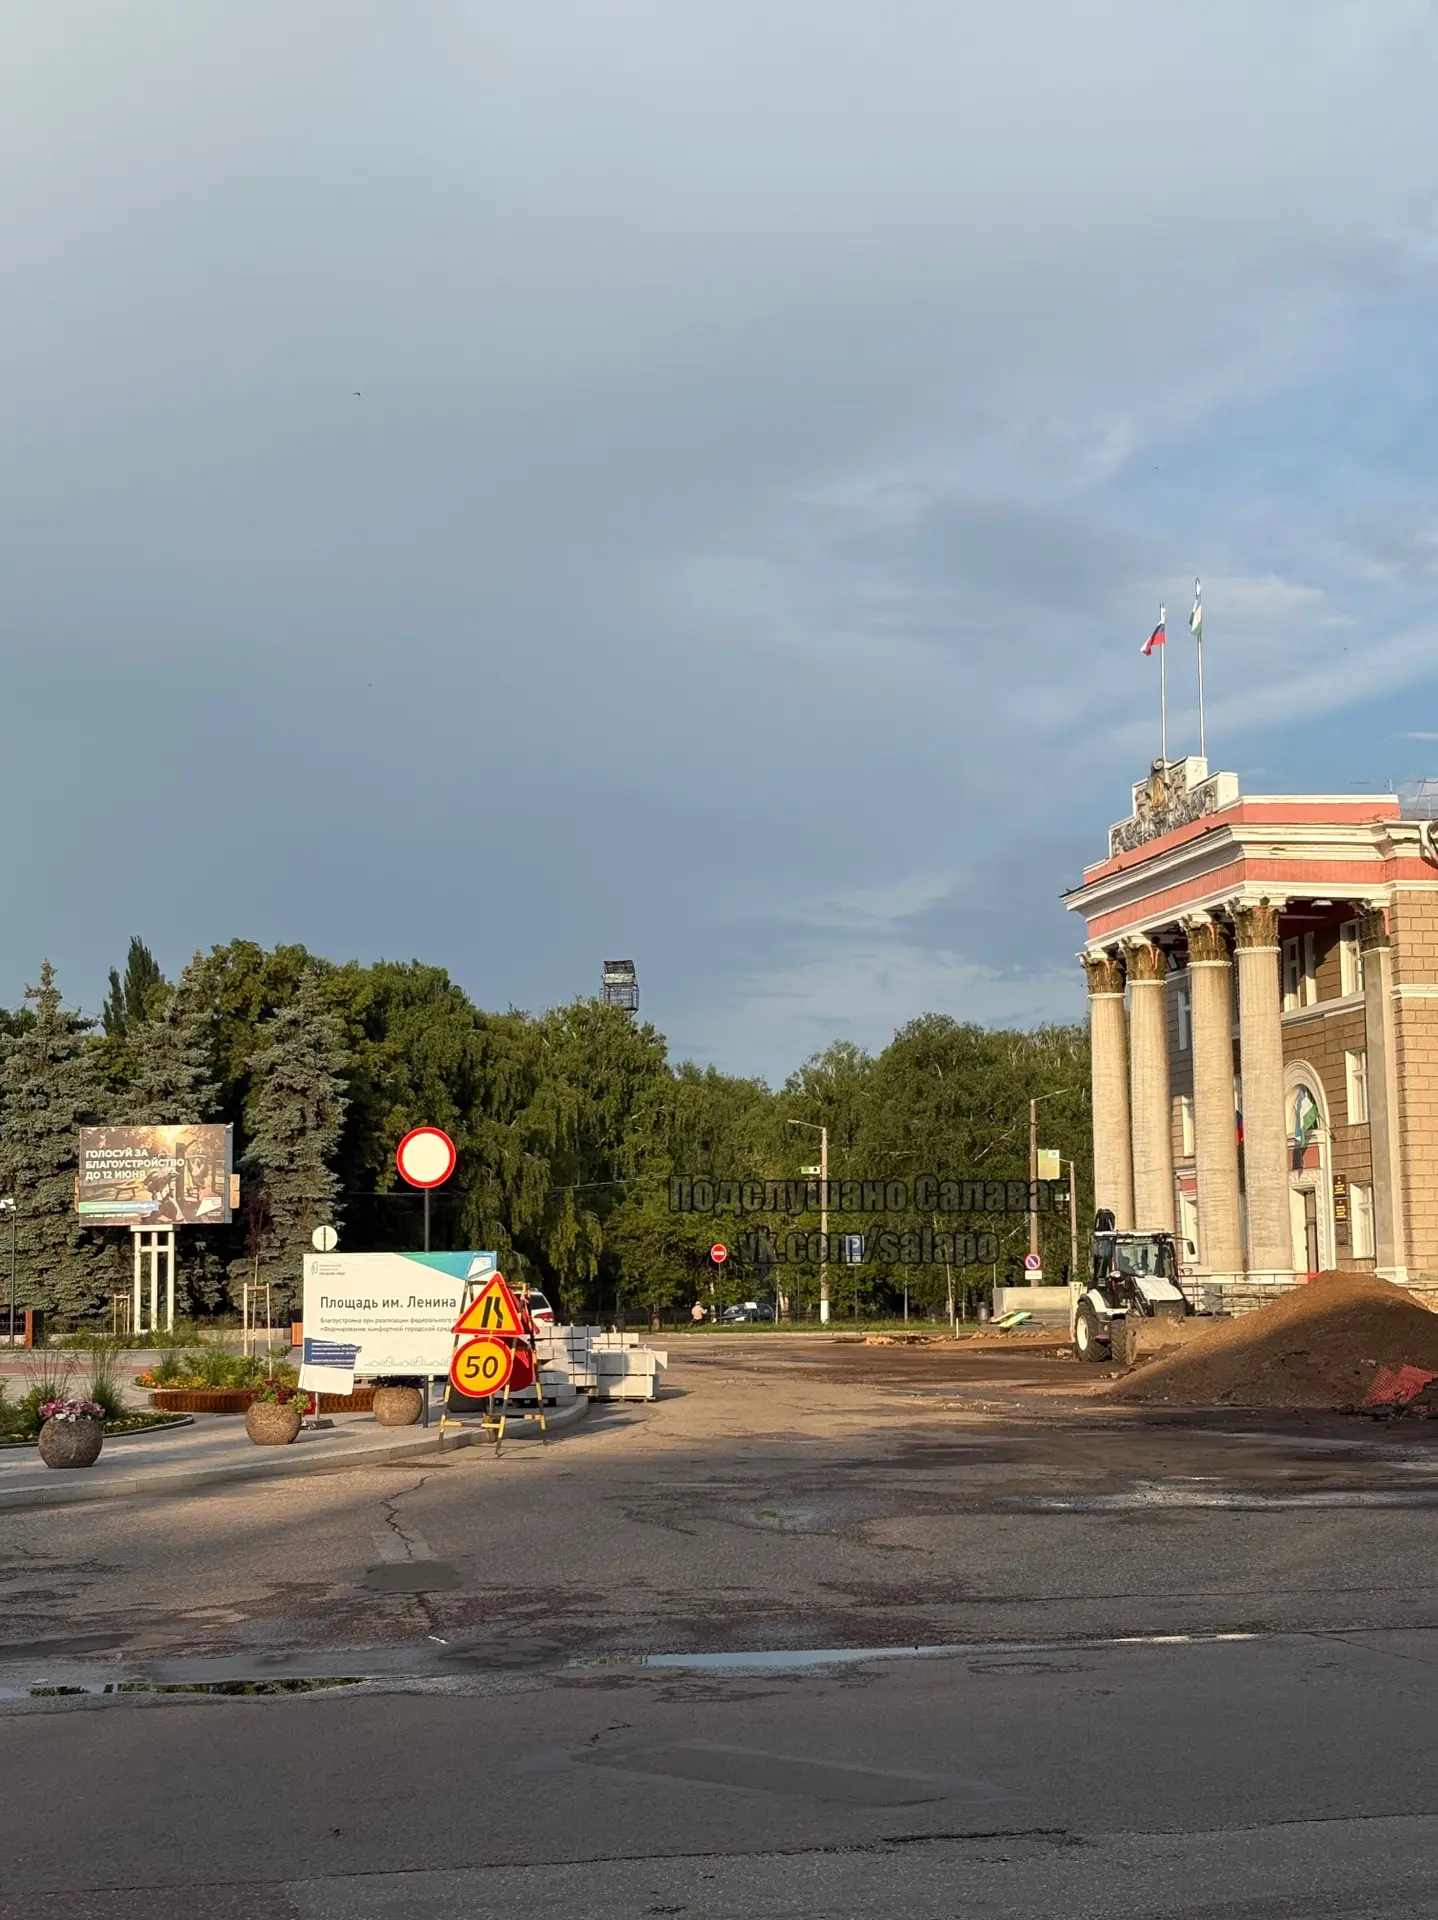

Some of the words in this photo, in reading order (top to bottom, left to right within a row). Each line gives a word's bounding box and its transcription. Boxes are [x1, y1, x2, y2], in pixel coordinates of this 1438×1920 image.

[85, 1148, 133, 1158] ГОЛОСУЙ
[134, 1148, 149, 1158] ЗА
[85, 1157, 185, 1170] БЛАГОУСТРОЙСТВО
[85, 1171, 101, 1181] ДО
[102, 1170, 113, 1180] 12
[116, 1170, 147, 1180] ИЮНЯ
[320, 1296, 378, 1310] Площадь
[382, 1299, 404, 1308] им.
[406, 1296, 457, 1308] Ленина
[464, 1355, 499, 1379] 50
